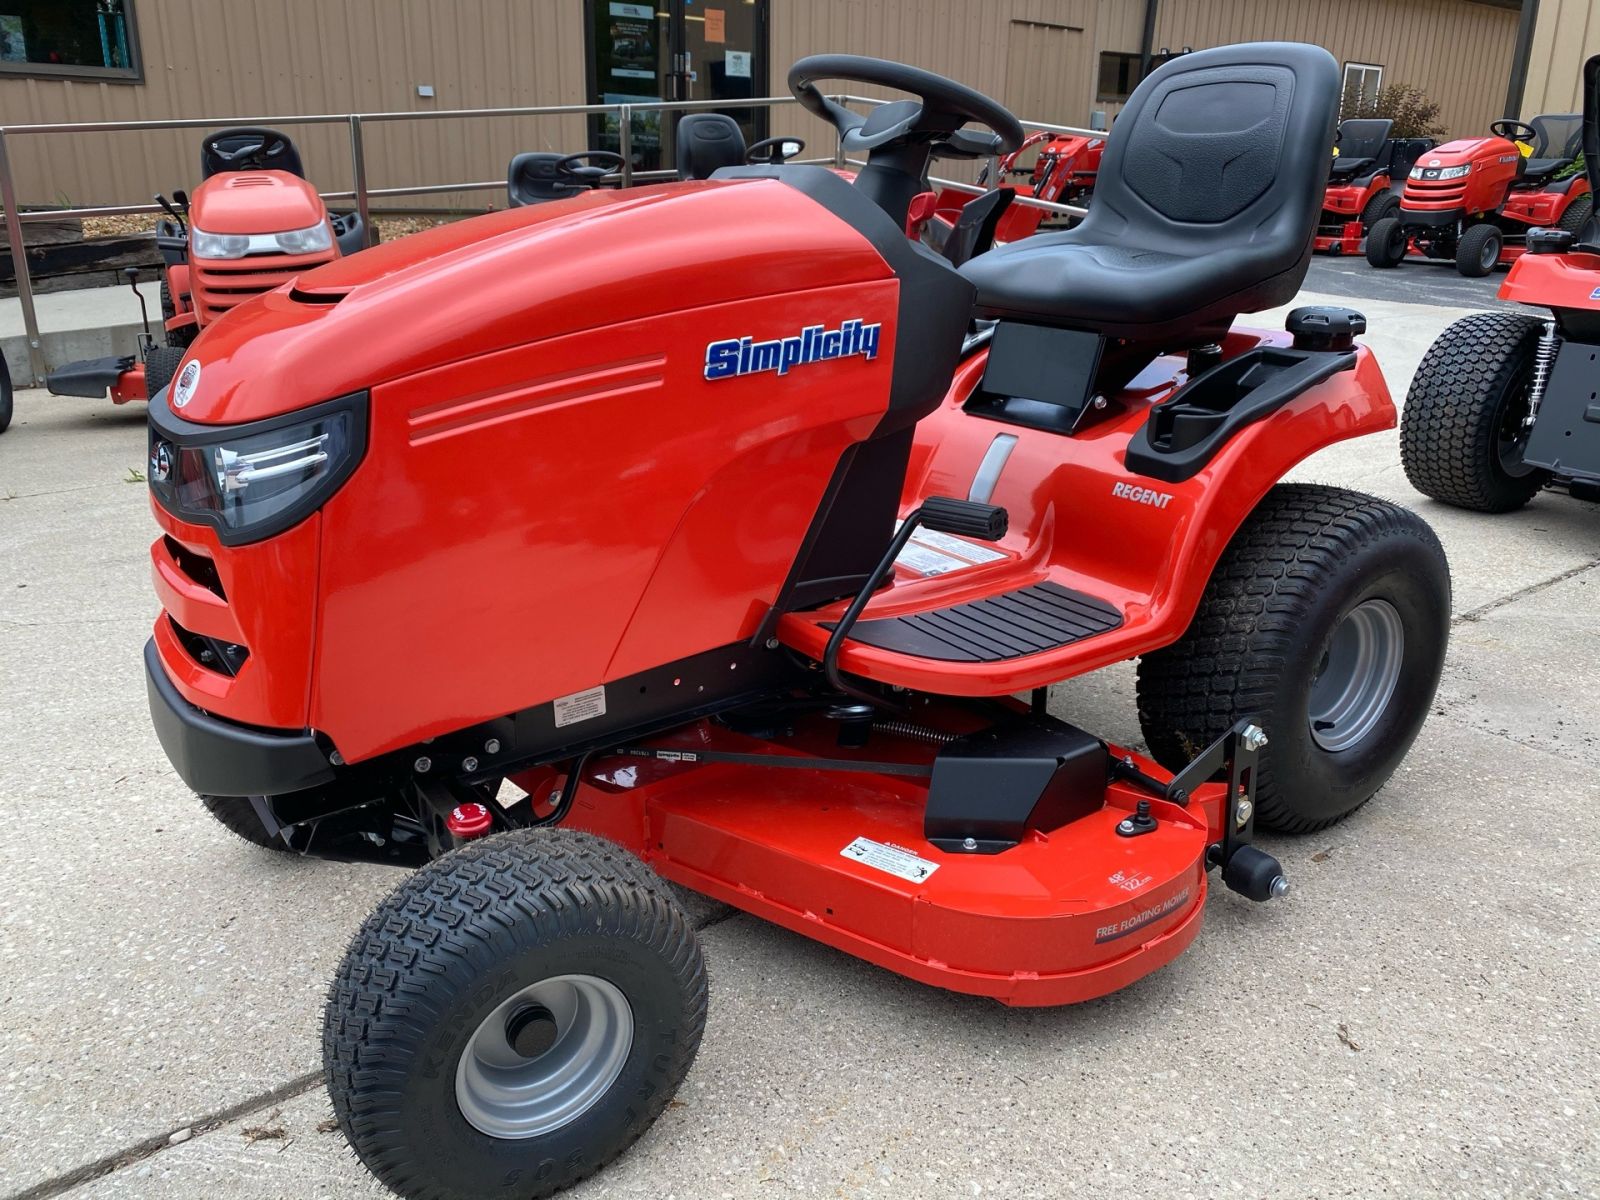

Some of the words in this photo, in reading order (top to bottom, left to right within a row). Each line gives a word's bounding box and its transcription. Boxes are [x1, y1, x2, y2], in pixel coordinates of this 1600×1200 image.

[703, 318, 882, 381] Simplicity
[1112, 481, 1174, 509] REGENT
[890, 843, 918, 855] DANGER
[1096, 924, 1118, 938] FREE
[1120, 904, 1161, 931] FLOATING
[422, 968, 519, 1080] KENDA
